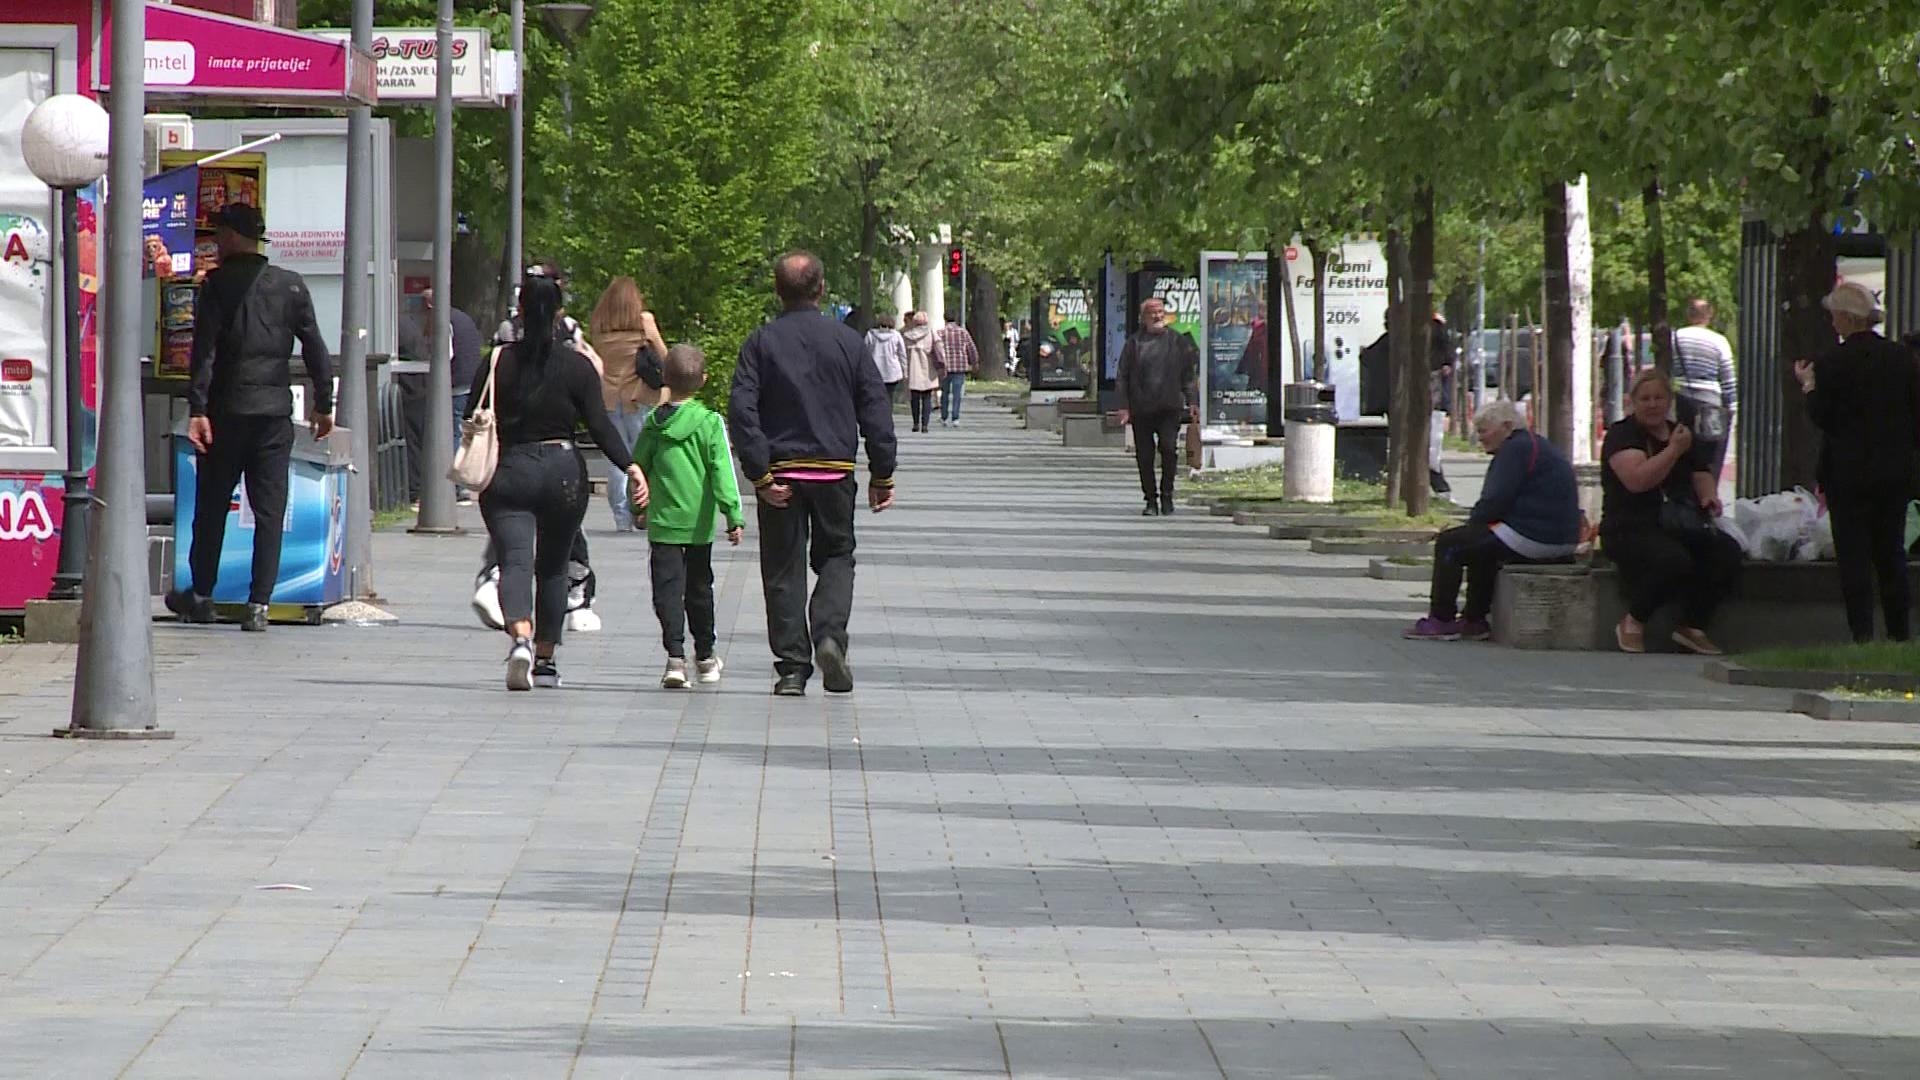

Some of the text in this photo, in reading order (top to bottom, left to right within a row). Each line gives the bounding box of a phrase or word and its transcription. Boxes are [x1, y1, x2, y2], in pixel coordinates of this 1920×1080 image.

[207, 56, 311, 72] imate prijatelje!
[389, 66, 408, 77] /ZA
[410, 67, 430, 76] SVE
[376, 78, 416, 88] KARATA
[143, 197, 167, 208] ALJ
[143, 208, 160, 219] RE
[1154, 277, 1181, 290] 20%
[1296, 275, 1315, 289] Fa
[1057, 299, 1088, 314] SVA
[1326, 311, 1360, 324] 20%
